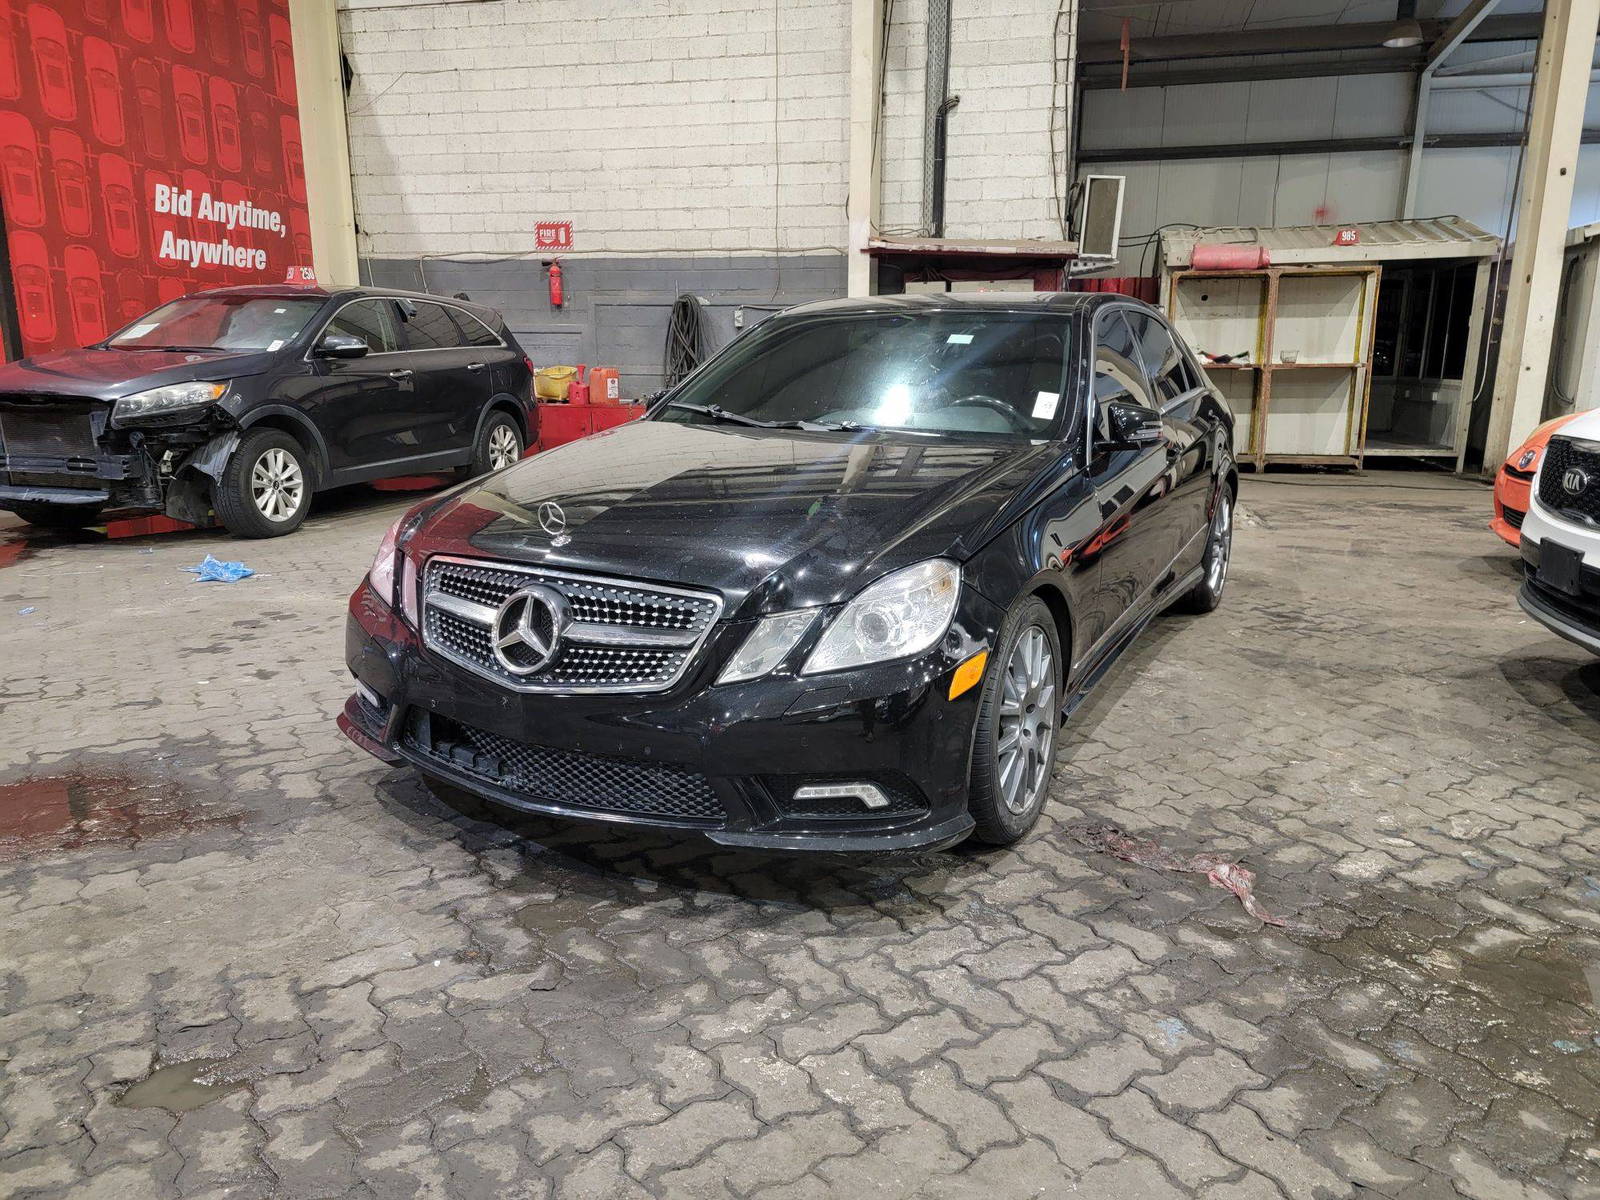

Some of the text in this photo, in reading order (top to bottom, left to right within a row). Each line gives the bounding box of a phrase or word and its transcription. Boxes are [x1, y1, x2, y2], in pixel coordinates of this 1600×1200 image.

[154, 183, 287, 238] Bid Anytime,
[159, 229, 267, 270] Anywhere
[539, 228, 557, 237] FIRE
